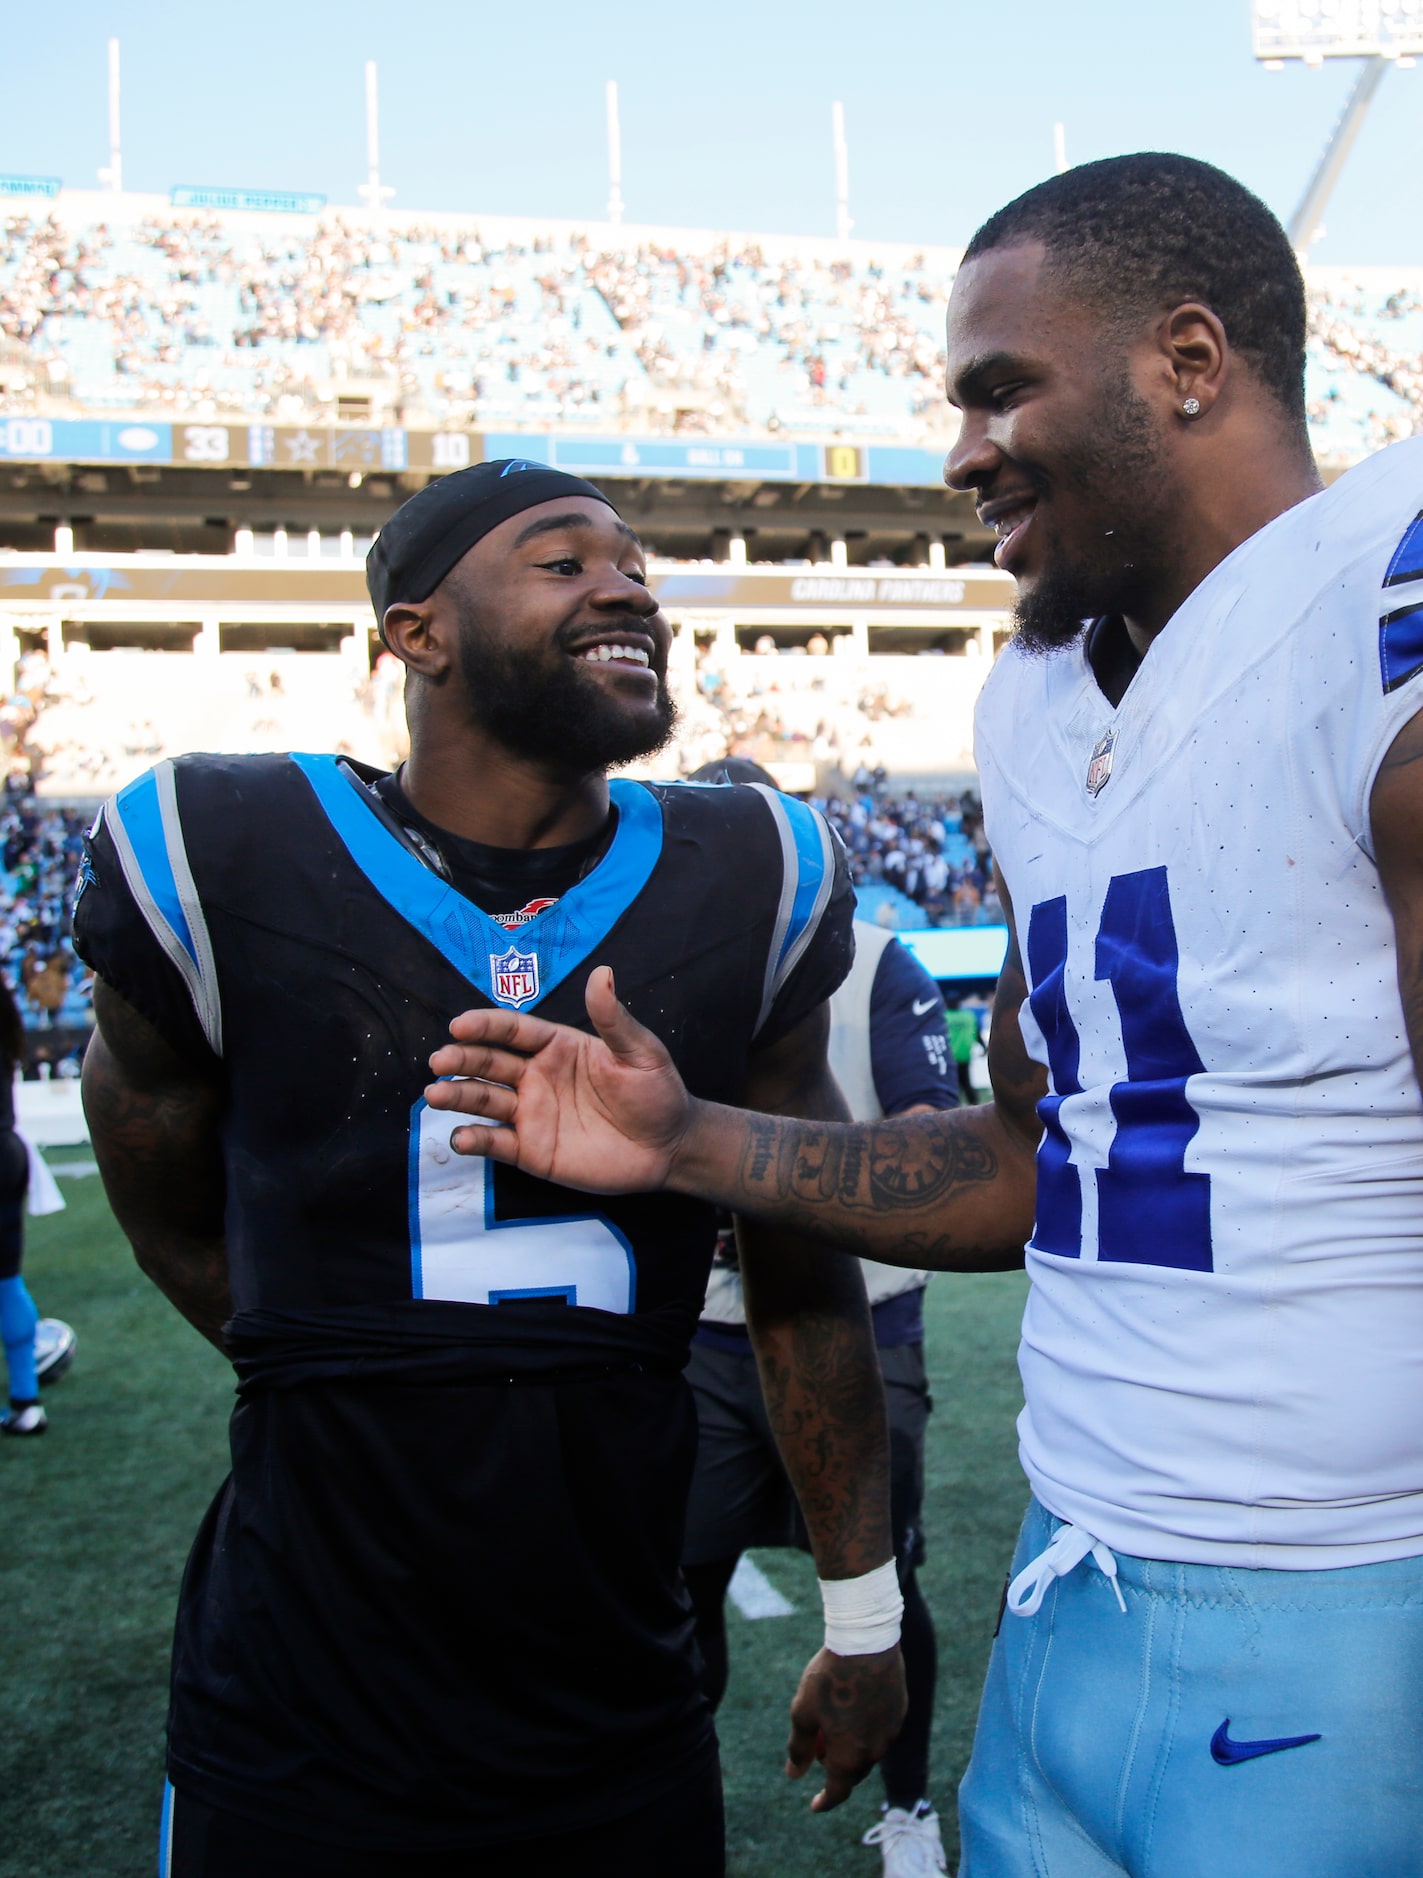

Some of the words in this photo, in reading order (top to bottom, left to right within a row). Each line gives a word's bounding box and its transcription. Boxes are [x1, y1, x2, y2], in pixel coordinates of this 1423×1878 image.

[244, 195, 309, 210] PEPPE
[184, 426, 229, 461] 33
[432, 433, 470, 467] 10
[791, 577, 877, 601] CAROLINA
[878, 578, 966, 604] PANTHERS
[499, 973, 533, 998] NFL
[1028, 865, 1215, 1273] 11
